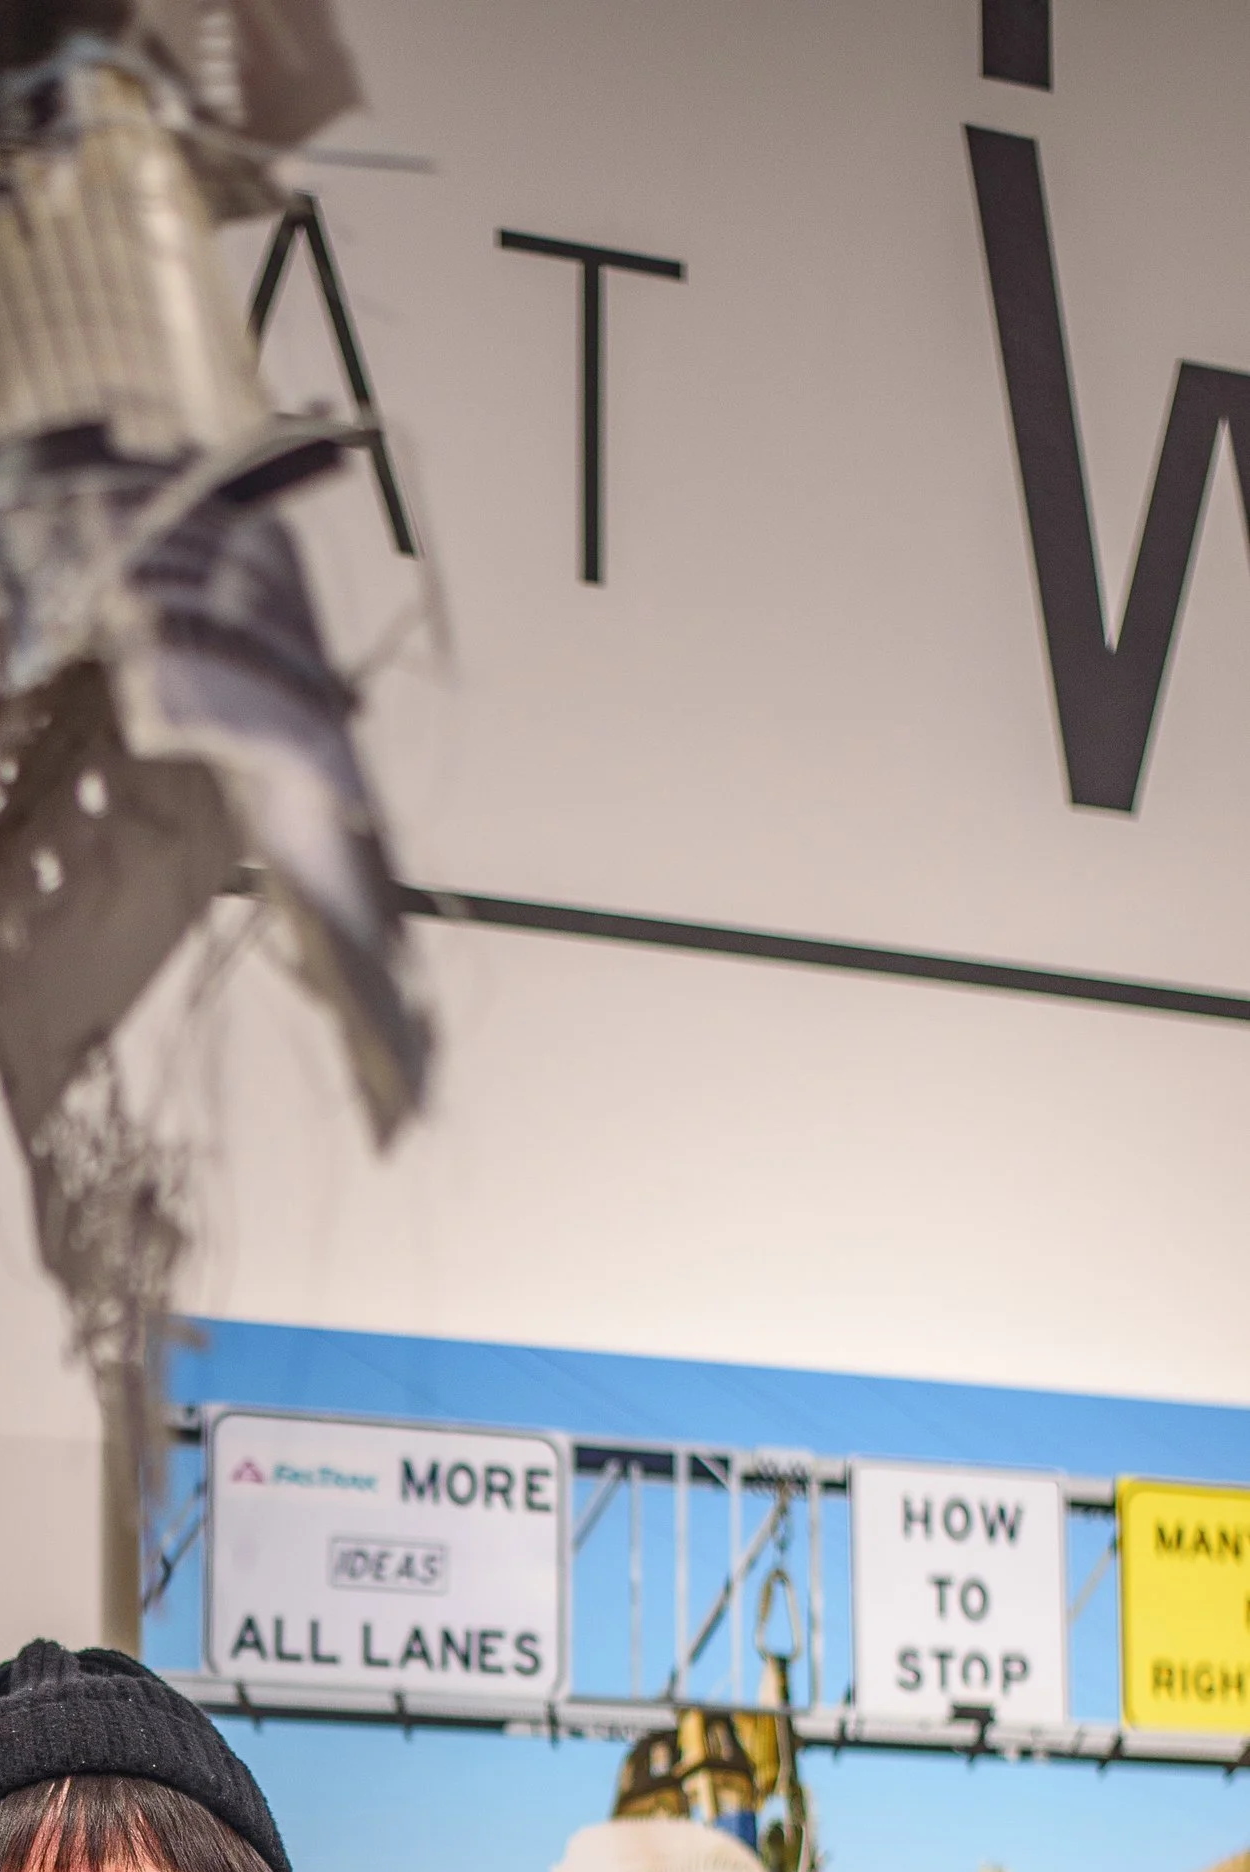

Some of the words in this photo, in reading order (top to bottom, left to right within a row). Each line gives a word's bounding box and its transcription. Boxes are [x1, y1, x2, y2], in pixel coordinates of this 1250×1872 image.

[401, 1459, 554, 1513] MORE
[902, 1494, 1024, 1546] HOW
[336, 1549, 440, 1585] IDEAS
[930, 1575, 991, 1622] TO
[230, 1614, 340, 1665] ALL
[362, 1621, 544, 1678] LANES
